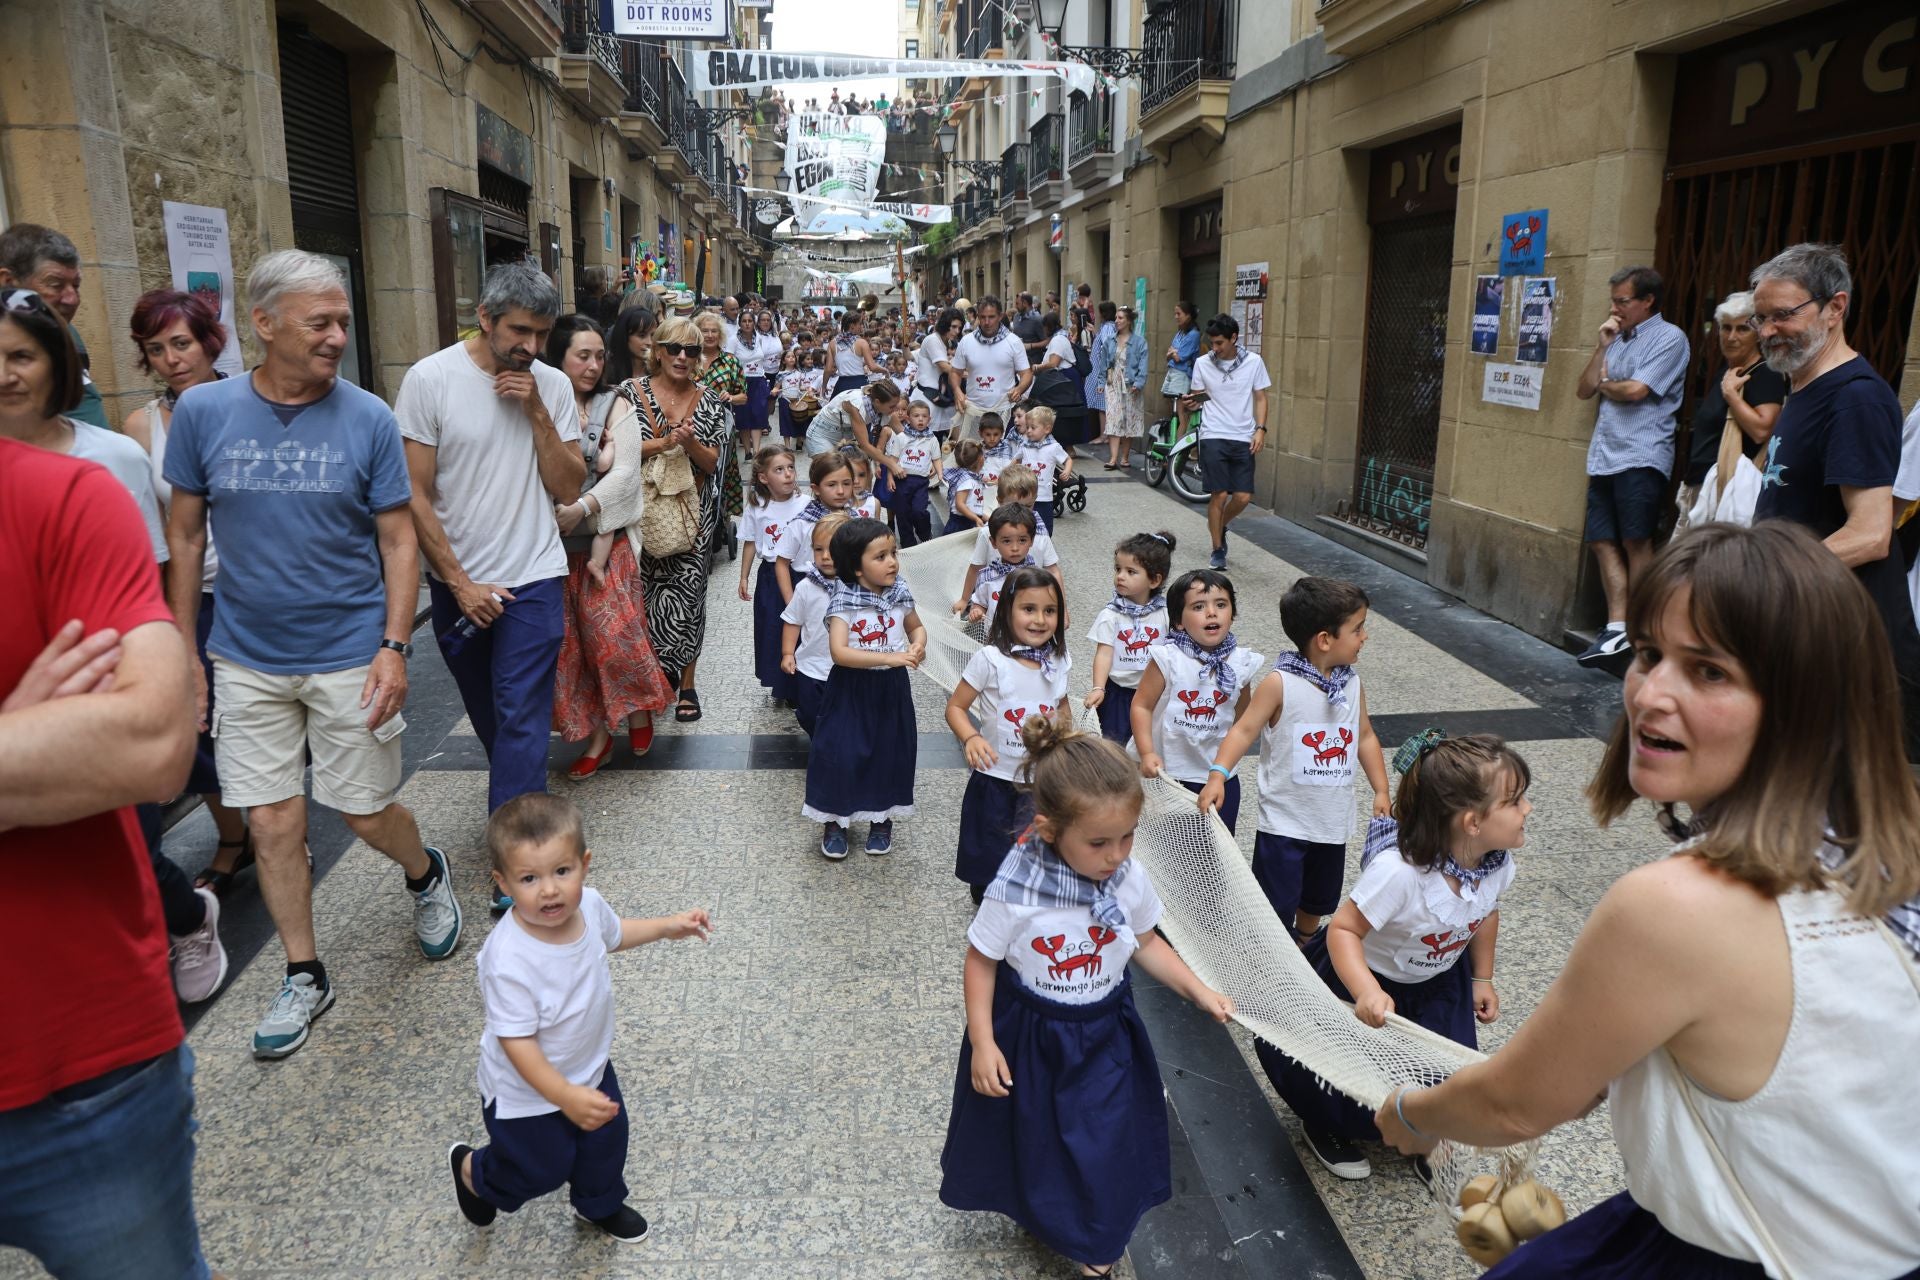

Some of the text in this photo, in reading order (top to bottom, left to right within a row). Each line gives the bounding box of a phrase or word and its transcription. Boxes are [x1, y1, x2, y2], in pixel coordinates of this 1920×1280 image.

[627, 5, 712, 22] DOT ROOMS
[795, 160, 834, 194] EGIN
[1235, 280, 1260, 298] askatu!
[1303, 766, 1341, 778] karmengo
[1035, 975, 1112, 995] karmengo jaiak
